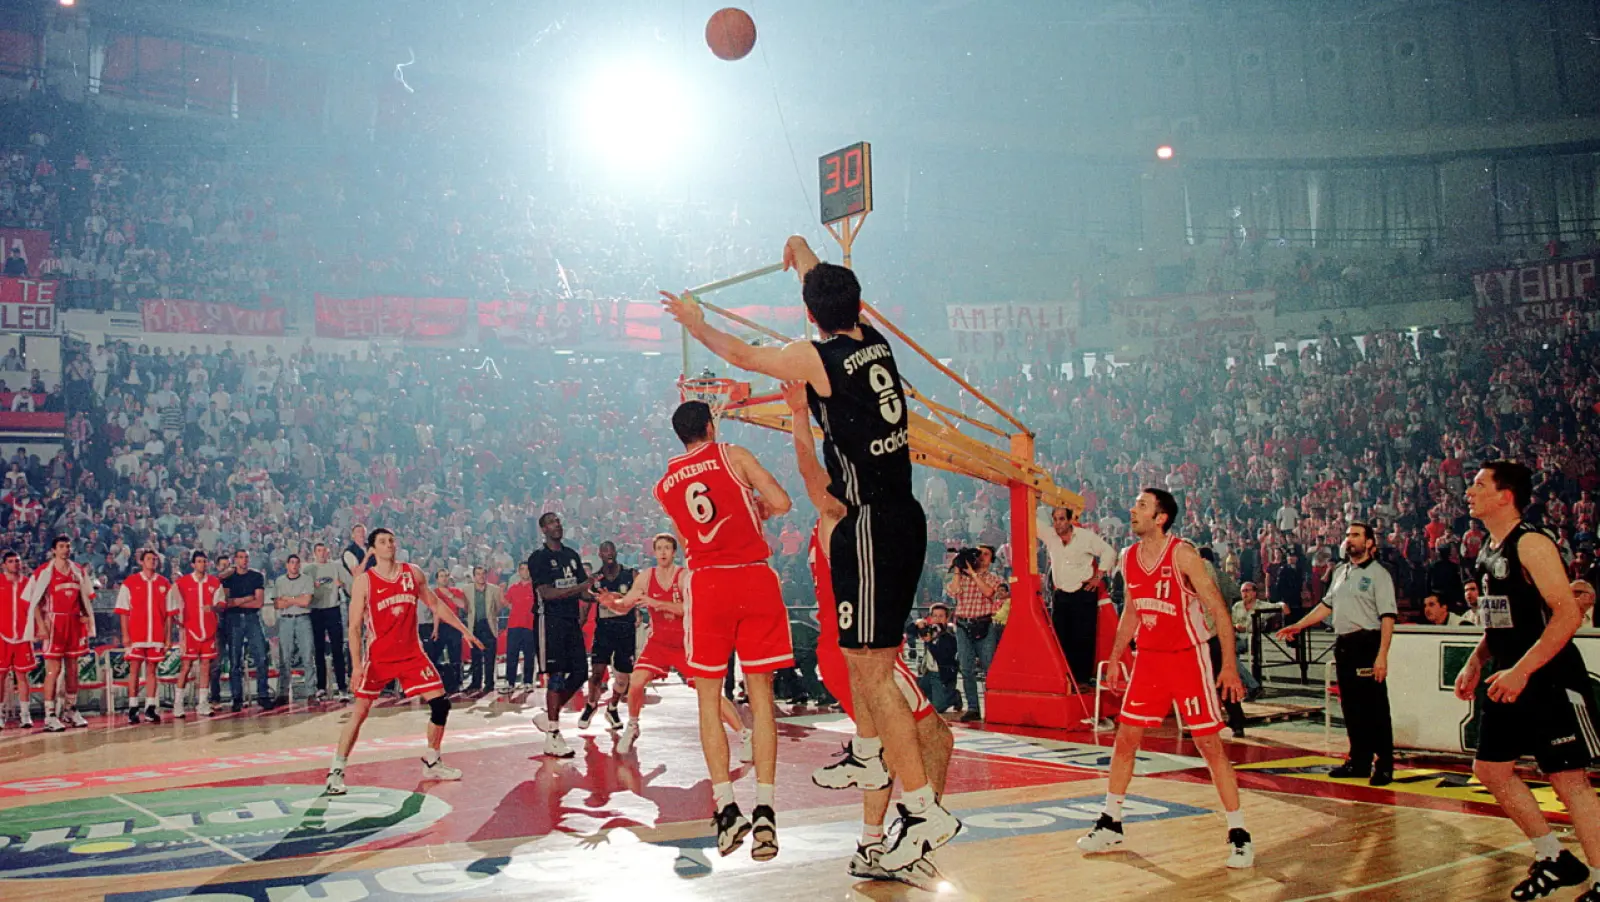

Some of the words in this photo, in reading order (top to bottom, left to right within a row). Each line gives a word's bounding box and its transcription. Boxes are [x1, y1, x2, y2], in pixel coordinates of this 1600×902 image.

[824, 149, 862, 195] 30
[685, 482, 716, 523] 6
[1154, 579, 1170, 599] 11
[838, 601, 853, 630] 8
[420, 666, 434, 681] 14
[1184, 696, 1201, 716] 11
[0, 791, 396, 853] Sprit
